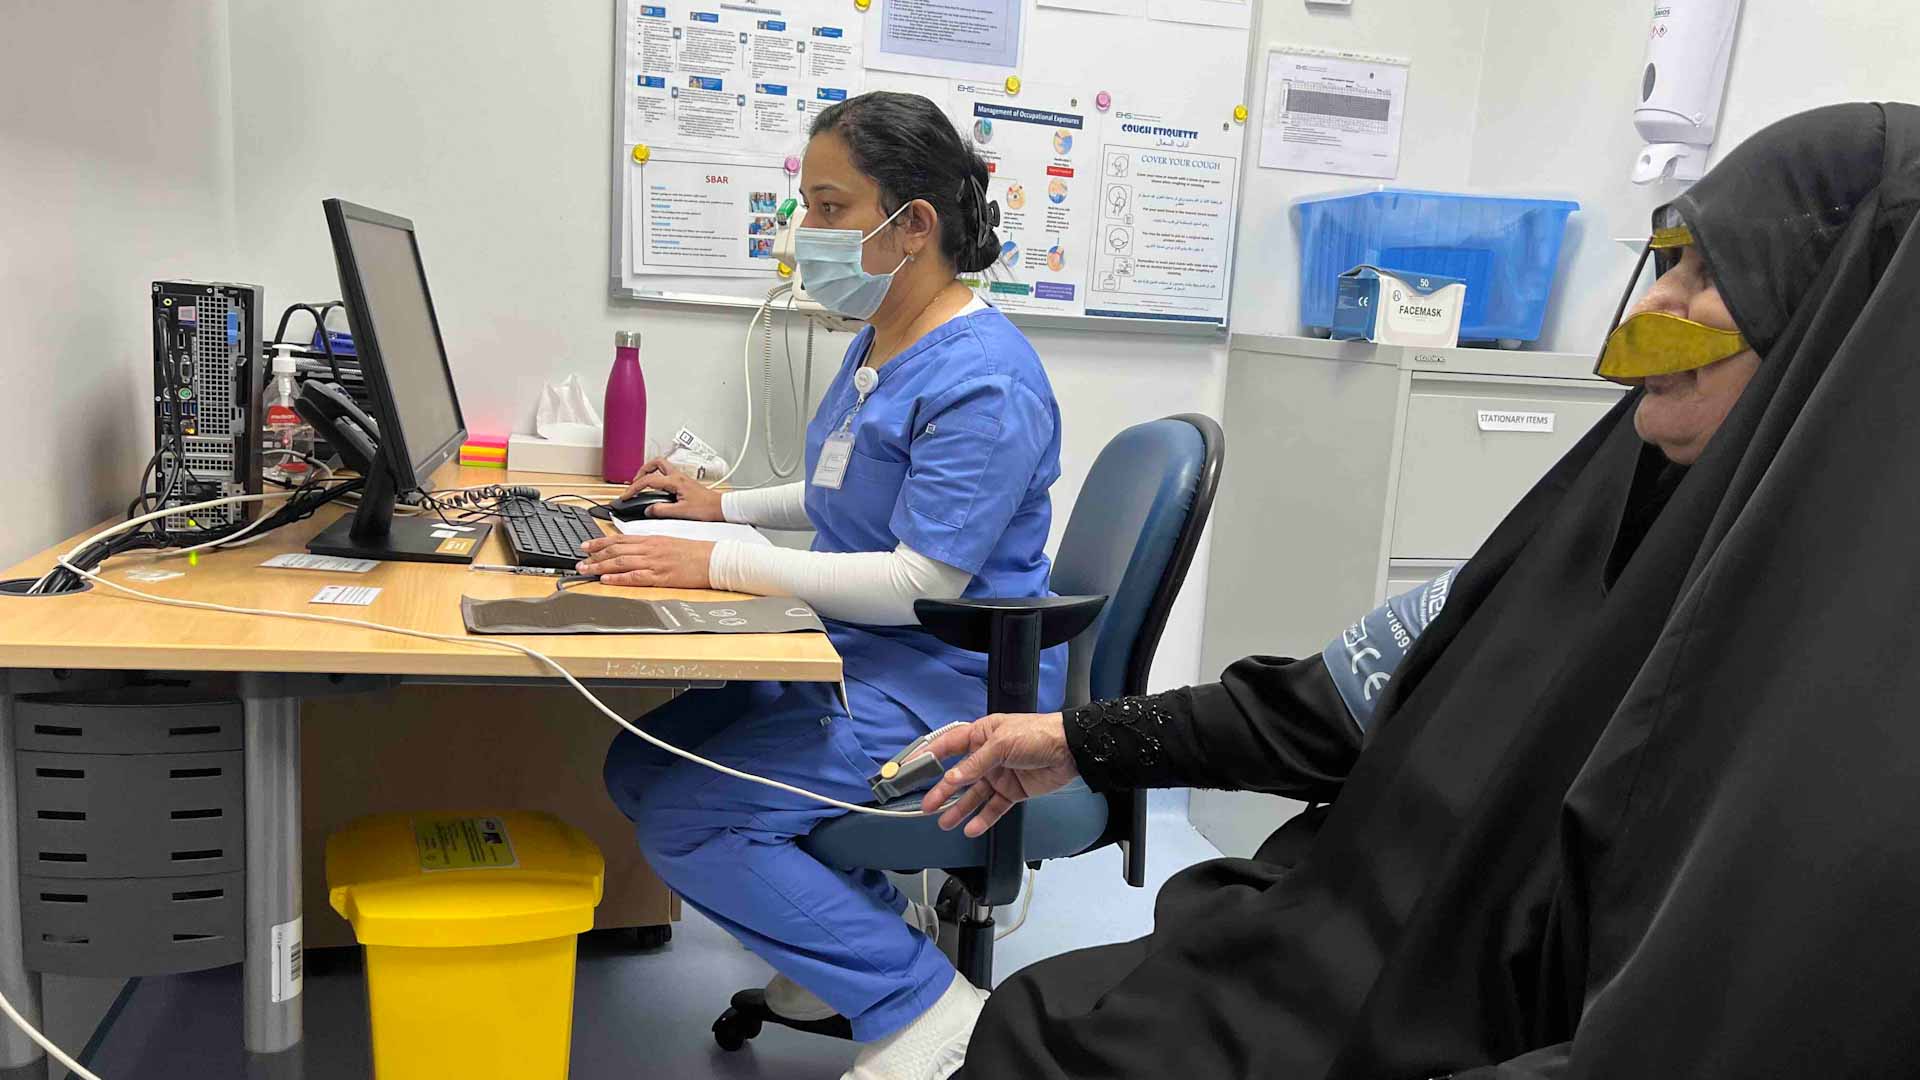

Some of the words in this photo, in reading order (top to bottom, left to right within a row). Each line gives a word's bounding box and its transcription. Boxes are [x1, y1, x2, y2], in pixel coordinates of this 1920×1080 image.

[977, 105, 1012, 116] Management
[1013, 109, 1020, 117] of
[1020, 110, 1054, 121] Occupational
[1054, 115, 1080, 125] Exposures
[1116, 111, 1132, 119] EHS
[1122, 123, 1151, 134] COUGH
[1153, 127, 1198, 139] ETIQUETTE
[1141, 155, 1167, 165] COVER
[1168, 158, 1191, 167] YOUR
[1191, 160, 1220, 170] COUGH
[705, 175, 729, 184] SBAR
[1420, 278, 1430, 287] 50
[1399, 305, 1442, 317] FACEMASK
[1480, 414, 1525, 423] STATIONARY
[1526, 416, 1548, 425] ITEMS
